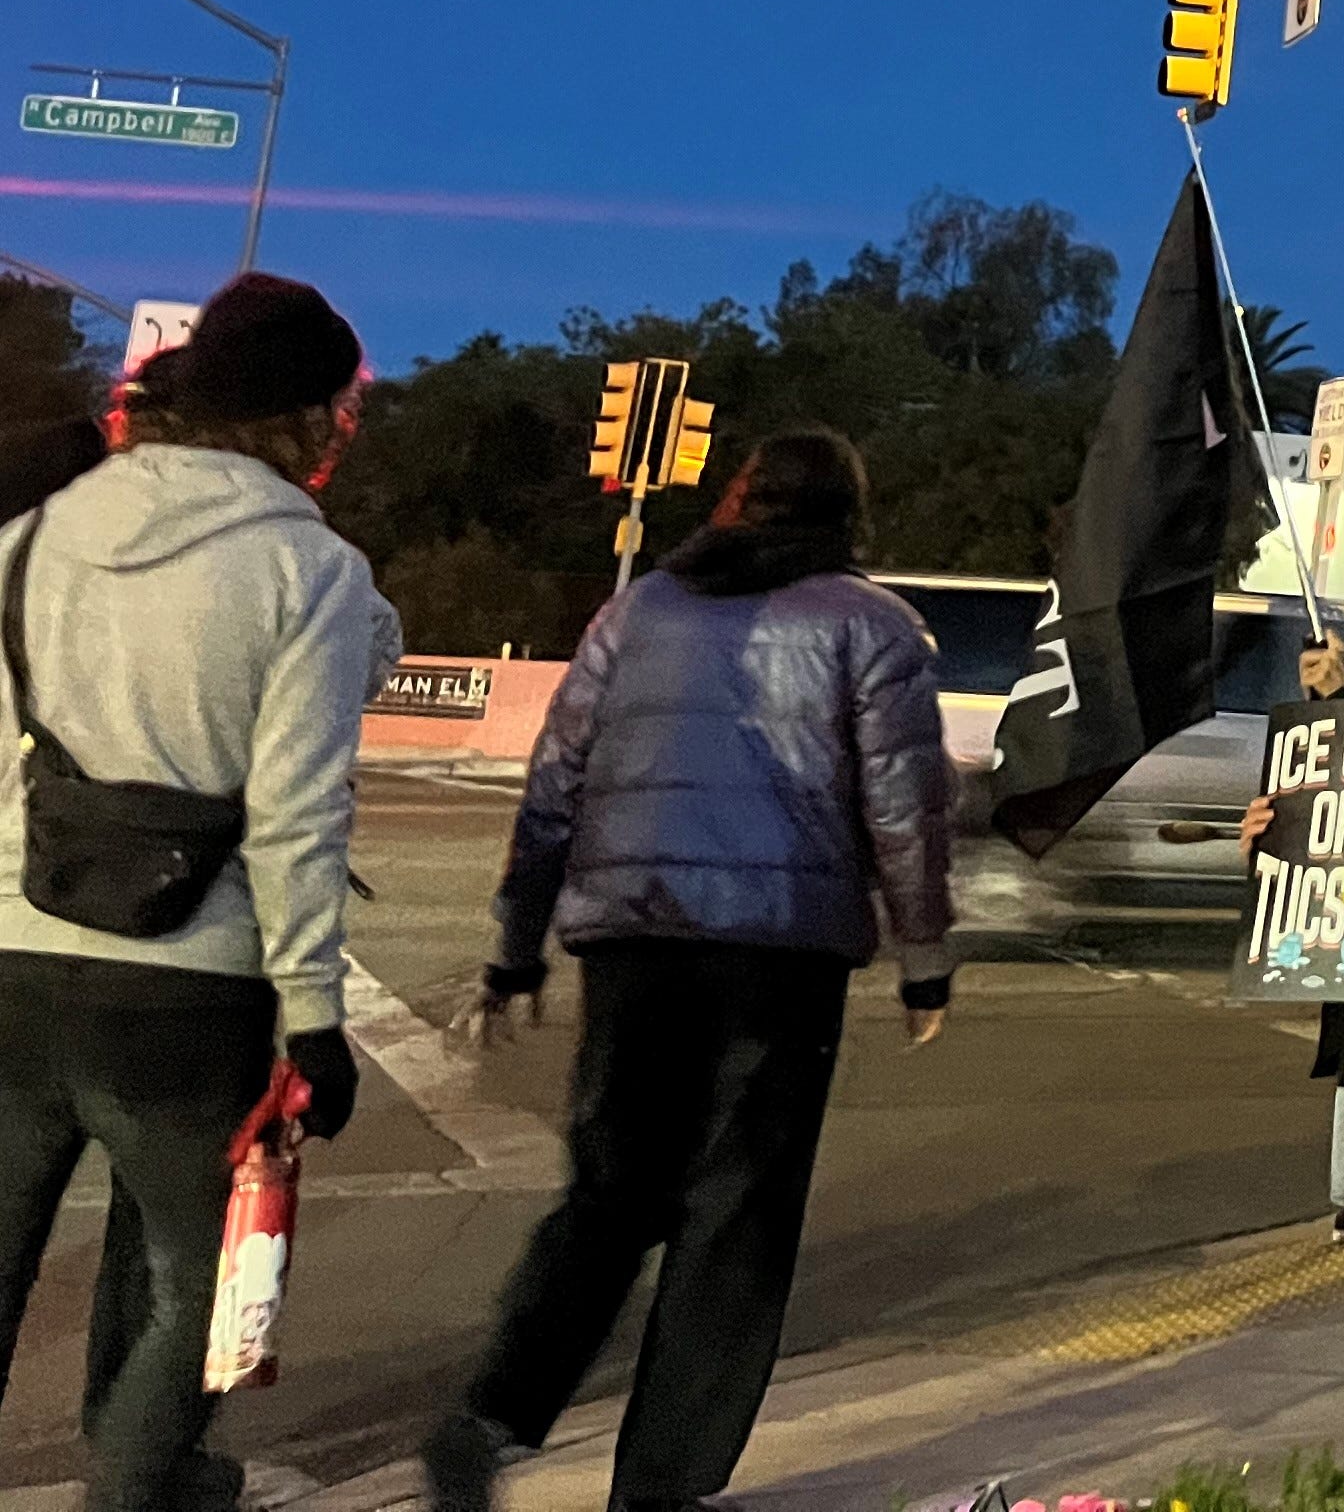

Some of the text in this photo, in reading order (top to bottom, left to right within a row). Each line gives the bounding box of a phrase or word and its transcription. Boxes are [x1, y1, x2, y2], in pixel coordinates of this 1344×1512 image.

[45, 101, 175, 134] Campbell
[438, 676, 487, 700] ELM
[1267, 717, 1337, 795] ICE
